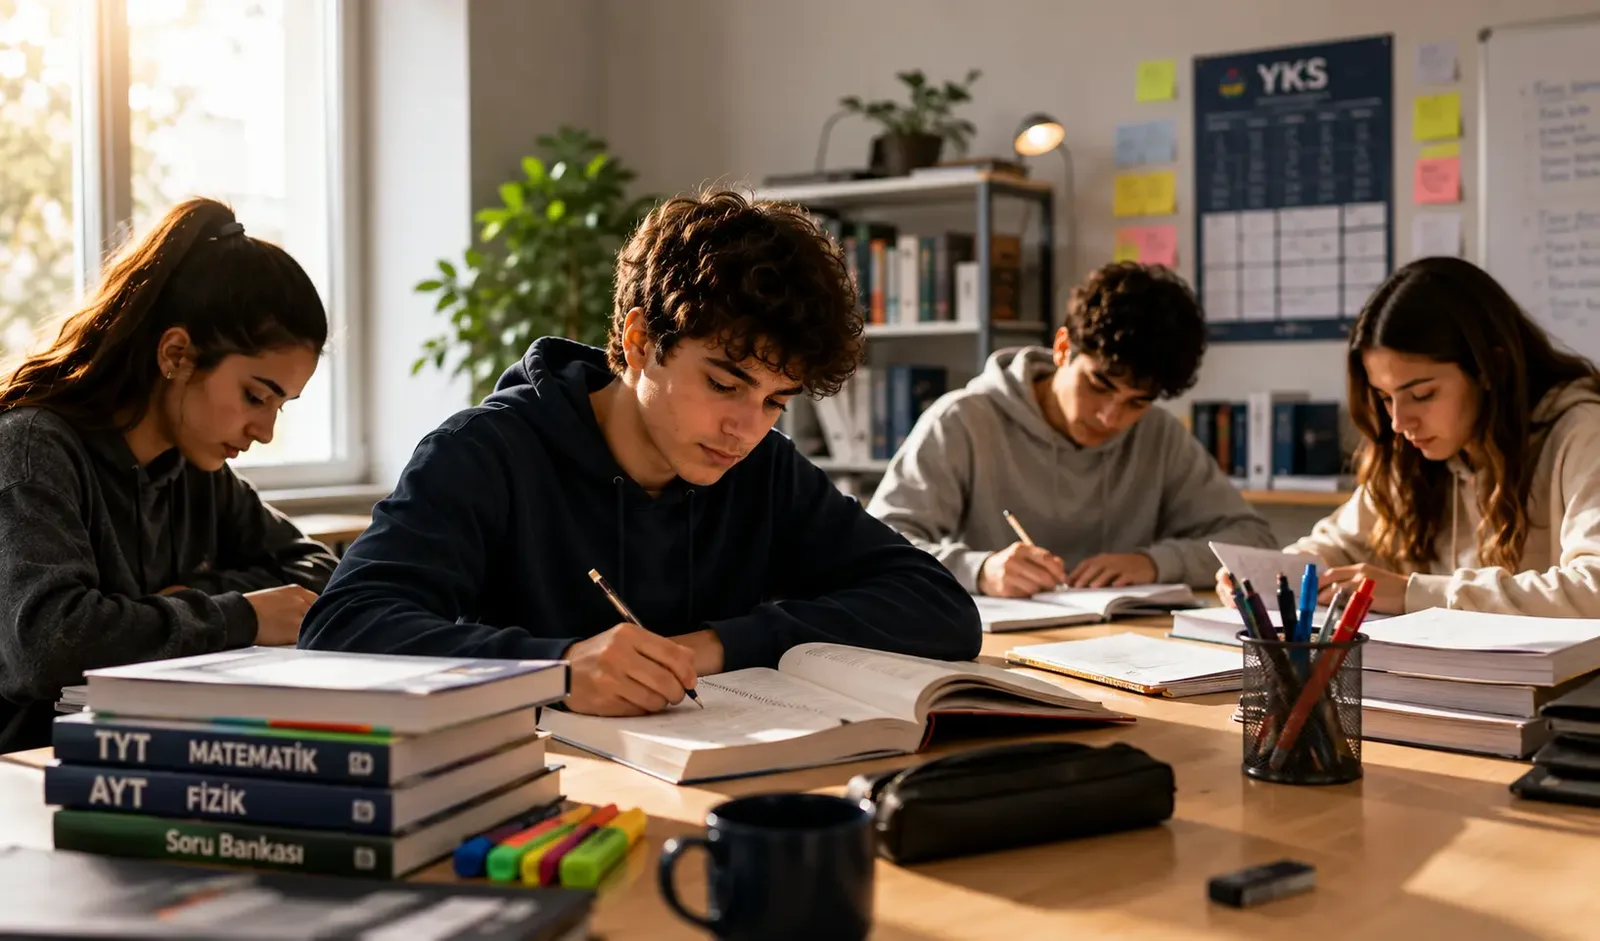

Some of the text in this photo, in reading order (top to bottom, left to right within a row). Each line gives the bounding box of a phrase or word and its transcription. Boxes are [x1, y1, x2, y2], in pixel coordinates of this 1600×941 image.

[1257, 57, 1328, 94] YKS
[94, 729, 318, 773] TYT MATEMATİK
[89, 774, 246, 815] AYT FİZİK
[166, 828, 304, 865] Soru Bankası
